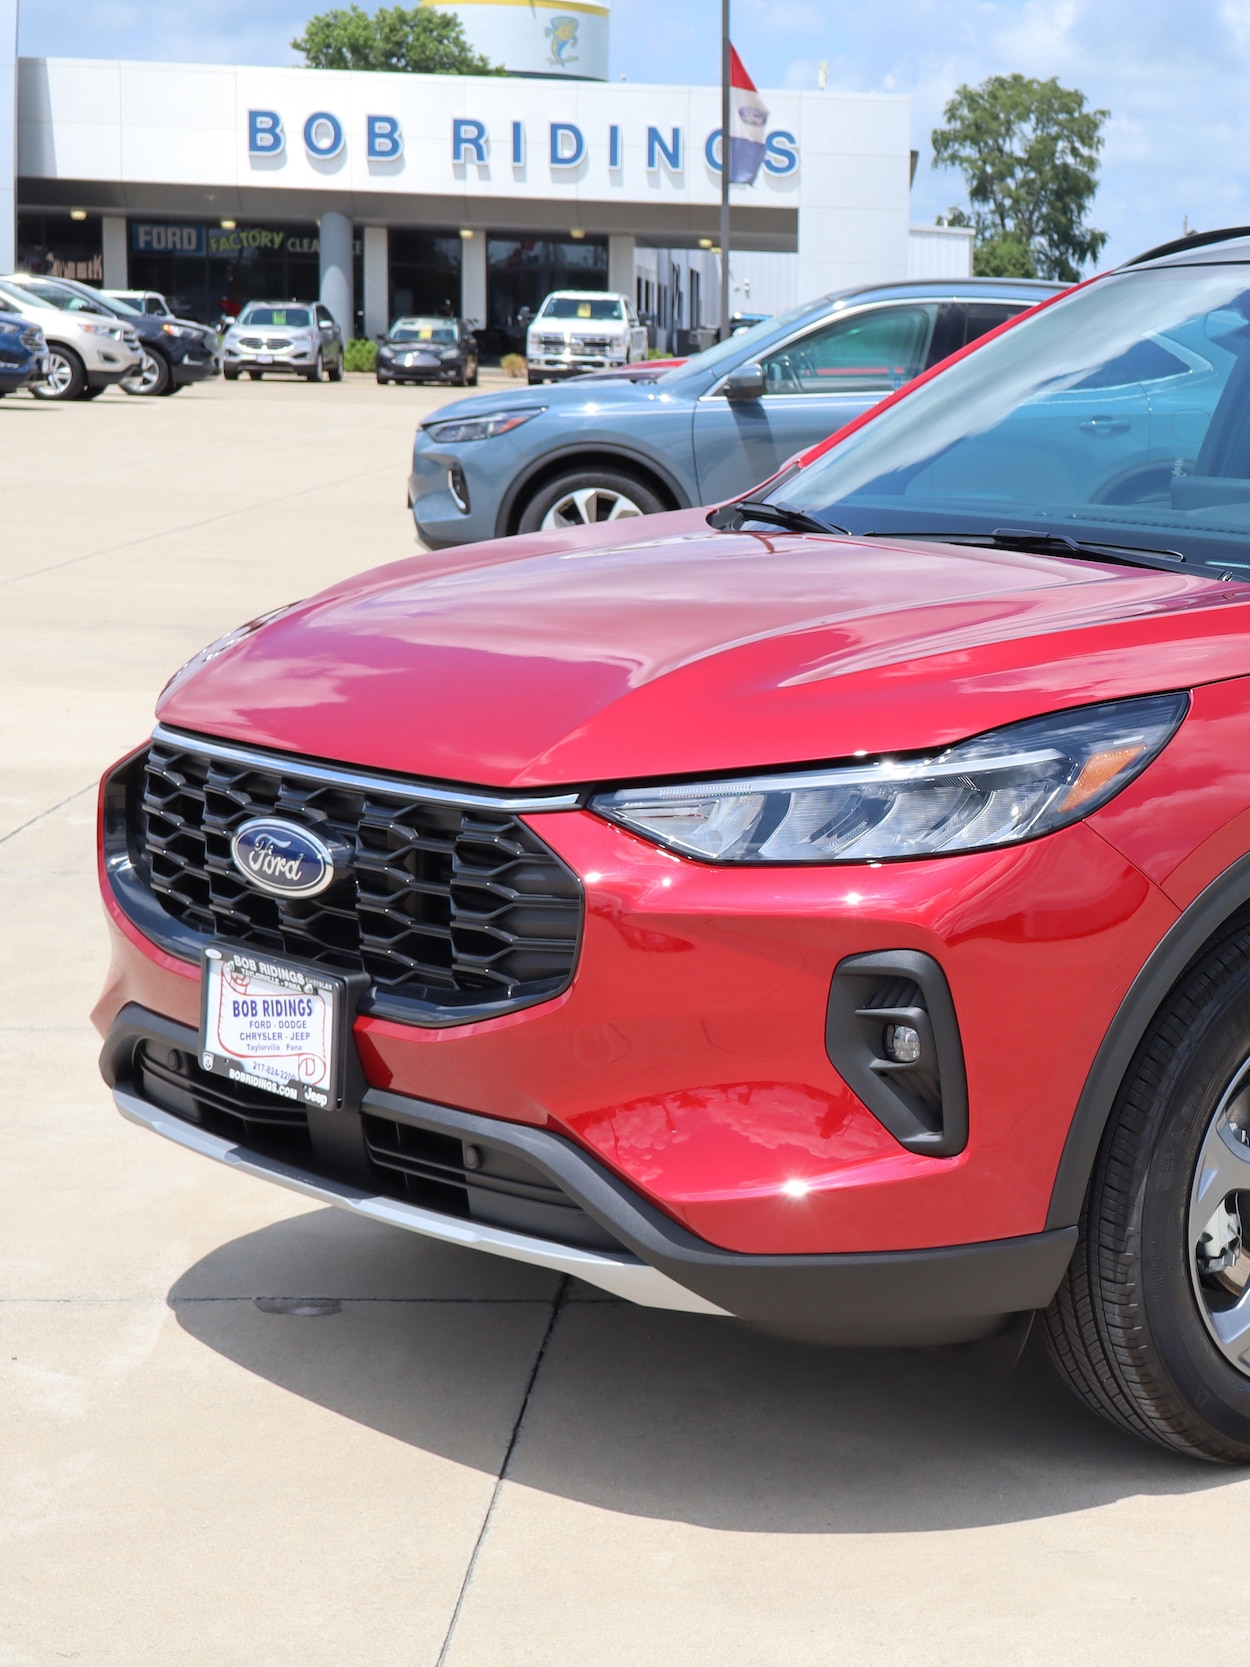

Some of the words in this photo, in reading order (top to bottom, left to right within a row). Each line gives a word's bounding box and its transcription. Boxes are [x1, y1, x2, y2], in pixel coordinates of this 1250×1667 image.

[249, 110, 402, 160] BOB
[138, 227, 198, 250] FORD
[209, 230, 284, 252] FACTORY
[249, 833, 305, 881] Ford
[233, 955, 258, 971] BOB
[259, 962, 305, 985] RIDINGS
[232, 1000, 258, 1018] BOB
[263, 999, 312, 1018] RIDINGS
[249, 1021, 271, 1029] FORD
[278, 1020, 307, 1029] DODGE
[240, 1032, 283, 1041] CHRYSLER
[290, 1032, 311, 1041] JEEP
[247, 1043, 280, 1052] Taylorville
[286, 1043, 302, 1051] Pana
[229, 1068, 298, 1100] BOBRIDINGS.COM
[304, 1086, 328, 1107] Jeep
